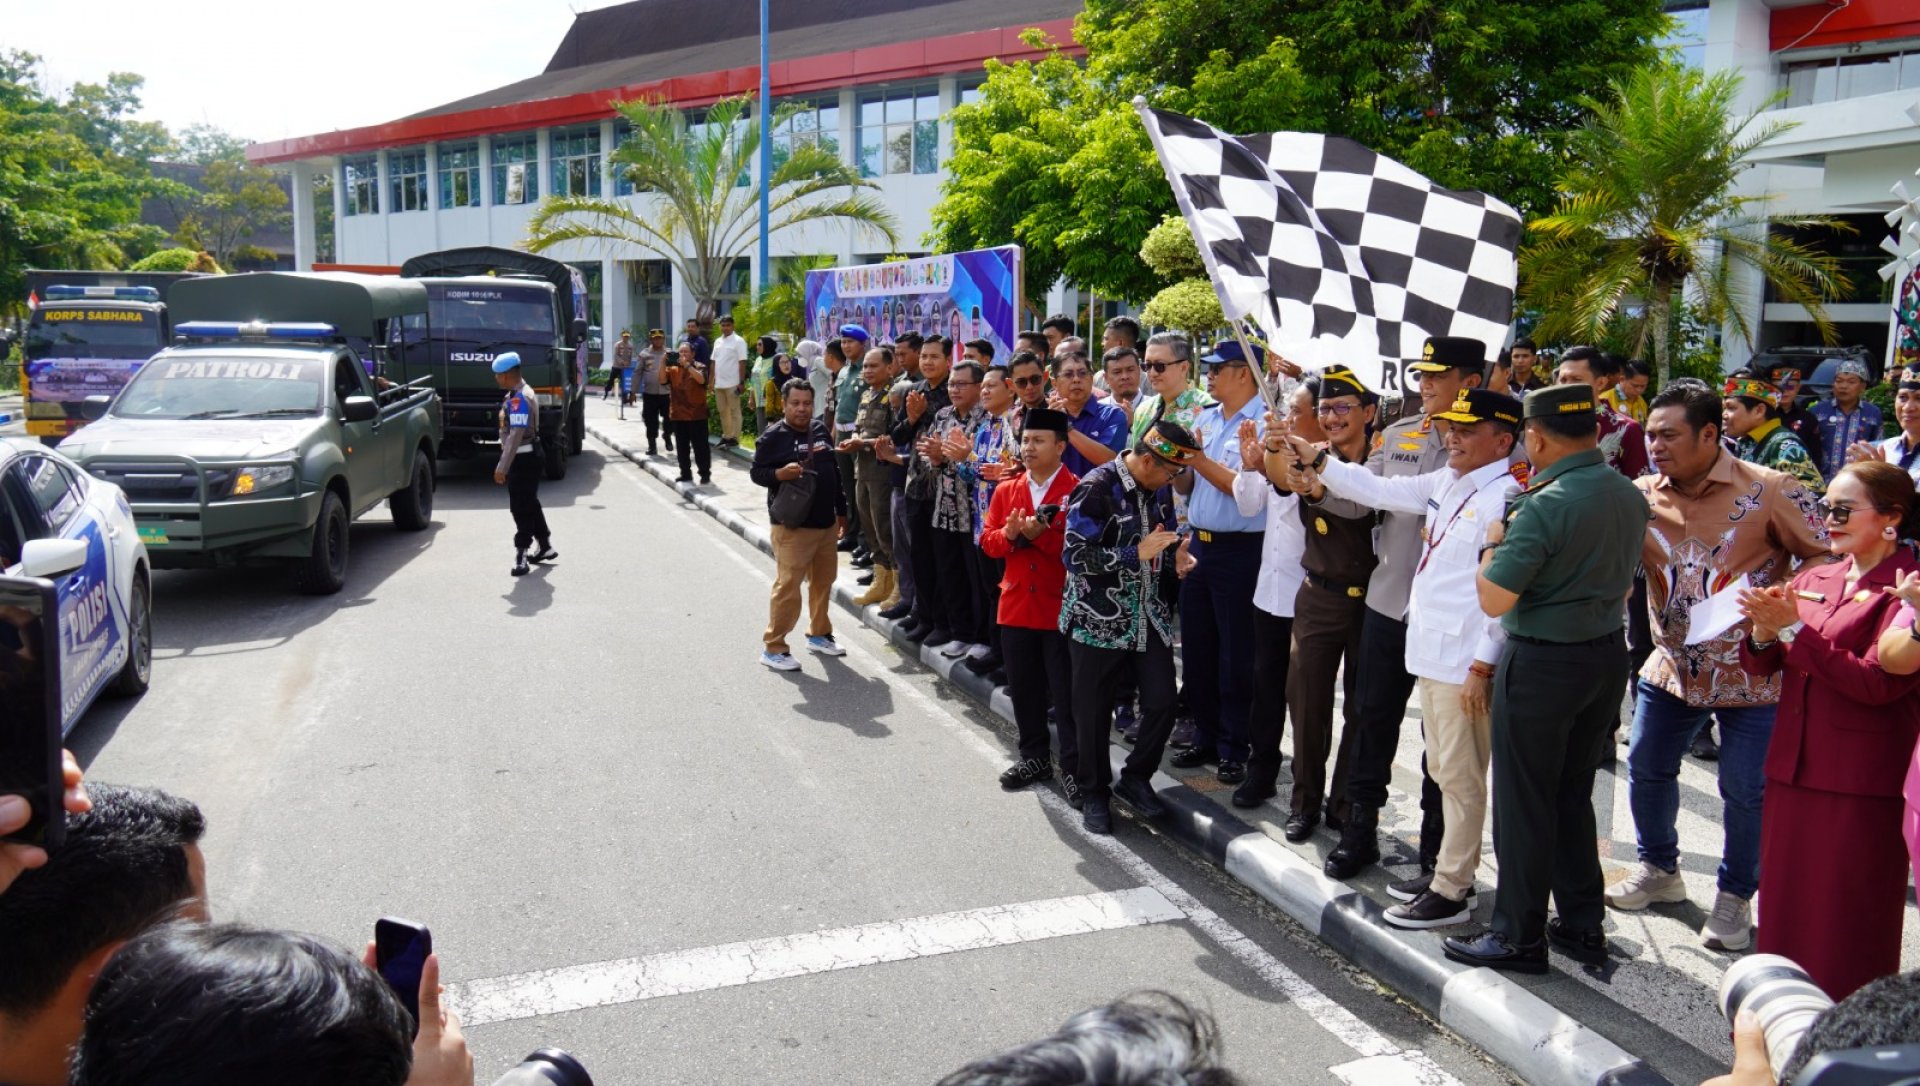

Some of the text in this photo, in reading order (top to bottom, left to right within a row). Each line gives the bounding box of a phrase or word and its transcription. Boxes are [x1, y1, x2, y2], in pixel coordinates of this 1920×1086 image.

[45, 310, 143, 322] KORPS SABHARA
[450, 353, 494, 361] ISUZU
[164, 361, 305, 380] PATROLI
[1390, 452, 1419, 463] IWAN
[68, 580, 108, 653] POLISI
